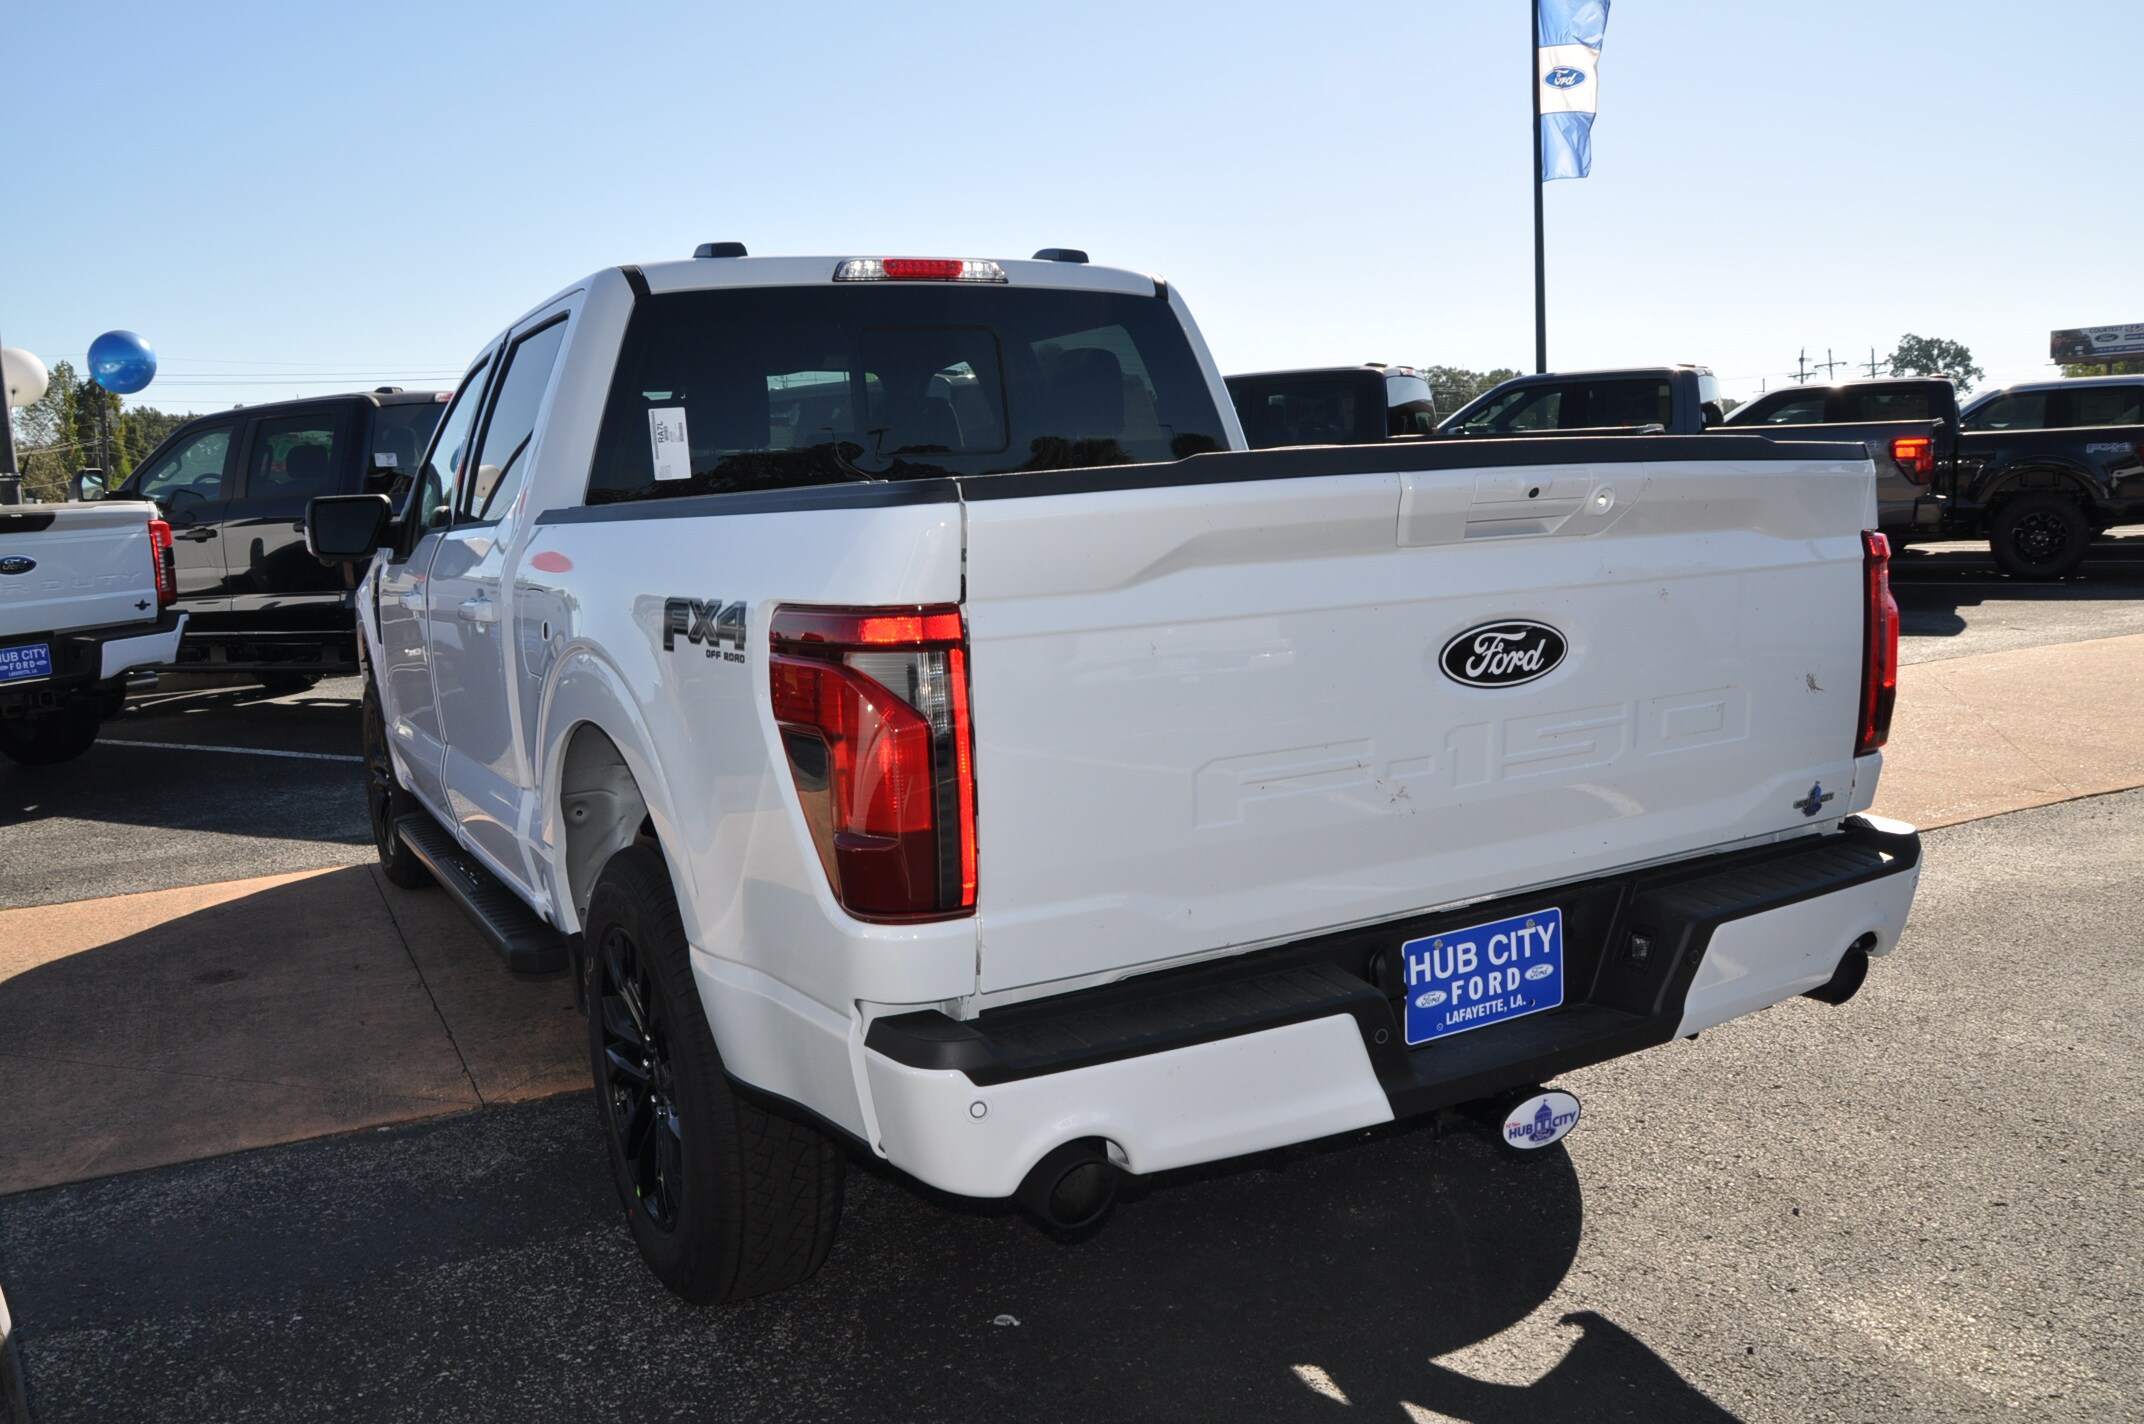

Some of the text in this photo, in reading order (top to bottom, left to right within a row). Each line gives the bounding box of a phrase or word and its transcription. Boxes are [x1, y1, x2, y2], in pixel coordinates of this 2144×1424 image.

[656, 420, 665, 443] RA7L
[41, 572, 141, 592] DUTY
[663, 596, 747, 653] FX4
[9, 661, 35, 670] FORD
[21, 648, 46, 660] CITY
[705, 649, 745, 664] OFF ROAD
[1465, 631, 1547, 678] Ford
[1192, 684, 1753, 830] F-150
[1409, 922, 1556, 986] HUB CITY
[1451, 967, 1521, 1006] FORD
[1445, 993, 1527, 1026] LAFAYETTE, LA.
[1508, 1111, 1577, 1140] HUB CITY
